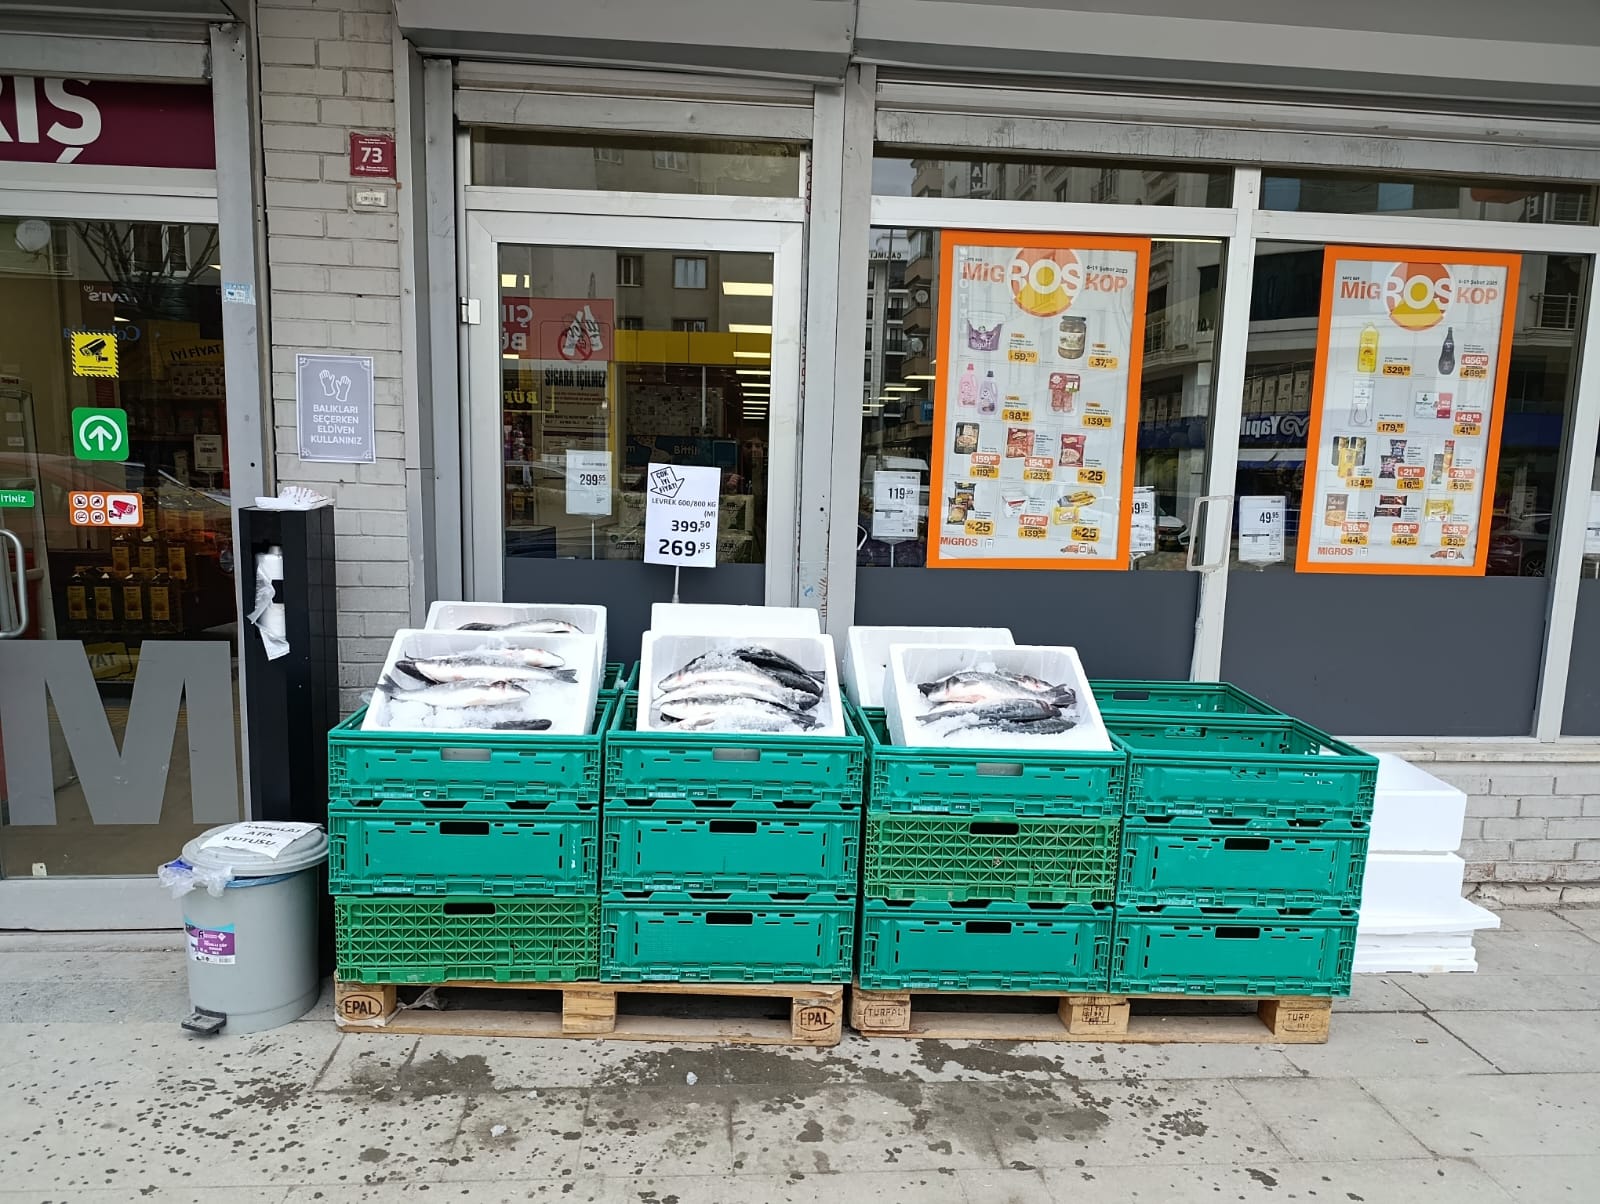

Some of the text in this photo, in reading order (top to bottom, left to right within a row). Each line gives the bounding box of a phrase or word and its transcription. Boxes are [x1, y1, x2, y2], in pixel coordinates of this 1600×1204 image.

[361, 147, 383, 163] 73
[545, 364, 606, 390] SİGARA İÇİLMEZ
[312, 404, 358, 414] BALIKLARI
[312, 414, 359, 425] SEÇERKEN
[317, 423, 355, 434] ELDİVEN
[310, 434, 363, 445] KULLANINIZ
[652, 497, 676, 506] LEVREK
[678, 499, 706, 508] 600/800
[1259, 511, 1280, 525] 49,95
[671, 519, 711, 533] 399,50
[658, 538, 711, 557] 269,95
[223, 835, 277, 846] KUTUSU
[345, 1000, 376, 1015] EPAL
[800, 1011, 831, 1026] EPAL
